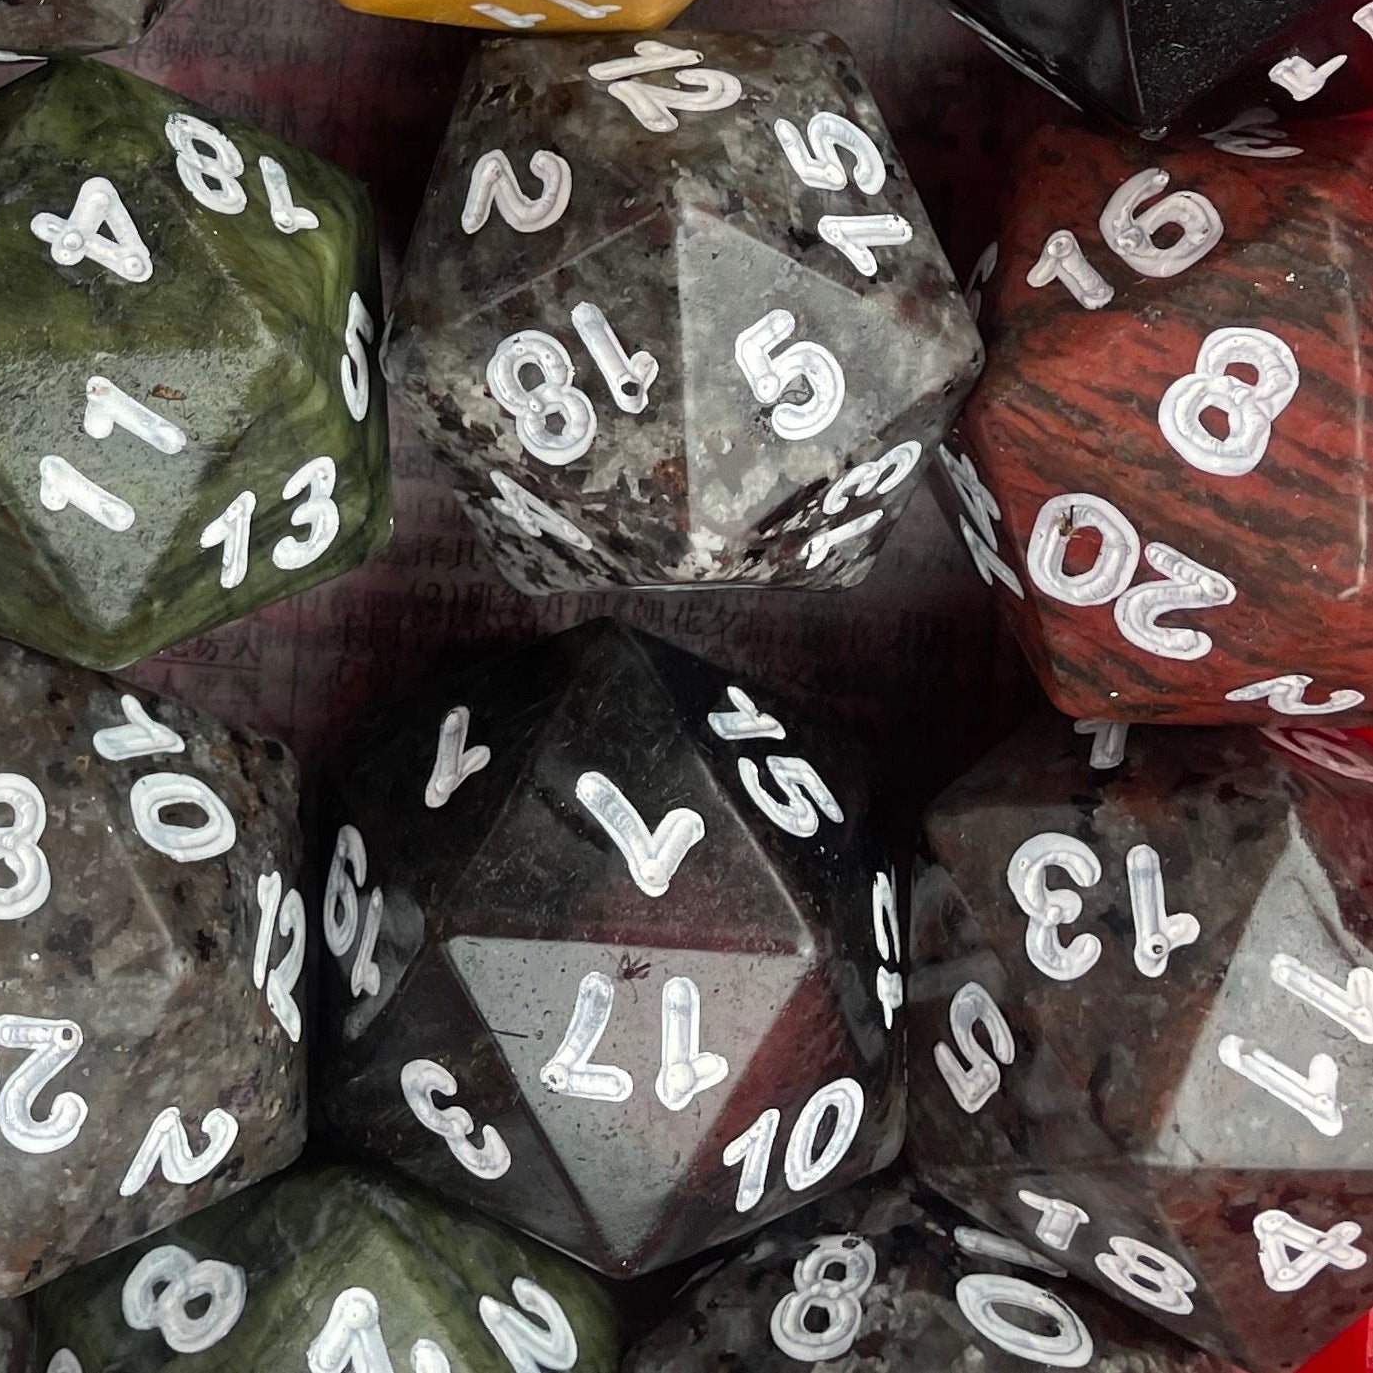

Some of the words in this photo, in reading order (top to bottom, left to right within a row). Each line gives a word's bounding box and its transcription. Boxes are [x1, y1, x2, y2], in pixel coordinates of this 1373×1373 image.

[588, 39, 742, 133] 12
[30, 176, 154, 283] 4
[163, 112, 320, 234] 18
[461, 149, 573, 235] 2
[773, 110, 913, 277] 15
[1026, 167, 1224, 310] 16
[486, 301, 659, 466] 18
[735, 308, 845, 441] 5
[1158, 326, 1299, 477] 8
[38, 375, 187, 532] 11
[800, 440, 922, 570] 13
[199, 455, 340, 589] 13
[1027, 492, 1237, 662] 20
[1225, 674, 1365, 716] 2
[92, 693, 237, 863] 10
[707, 686, 845, 838] 15
[252, 870, 306, 1043] 12
[1006, 832, 1201, 982] 13
[540, 971, 729, 1112] 17
[933, 981, 1016, 1114] 5
[120, 1107, 238, 1196] 2
[400, 1058, 512, 1180] 3
[723, 1077, 865, 1213] 10
[770, 1234, 877, 1363] 8
[953, 1225, 1094, 1369] 10
[1017, 1189, 1198, 1316] 18
[1253, 1209, 1368, 1293] 4
[479, 1276, 579, 1373] 2
